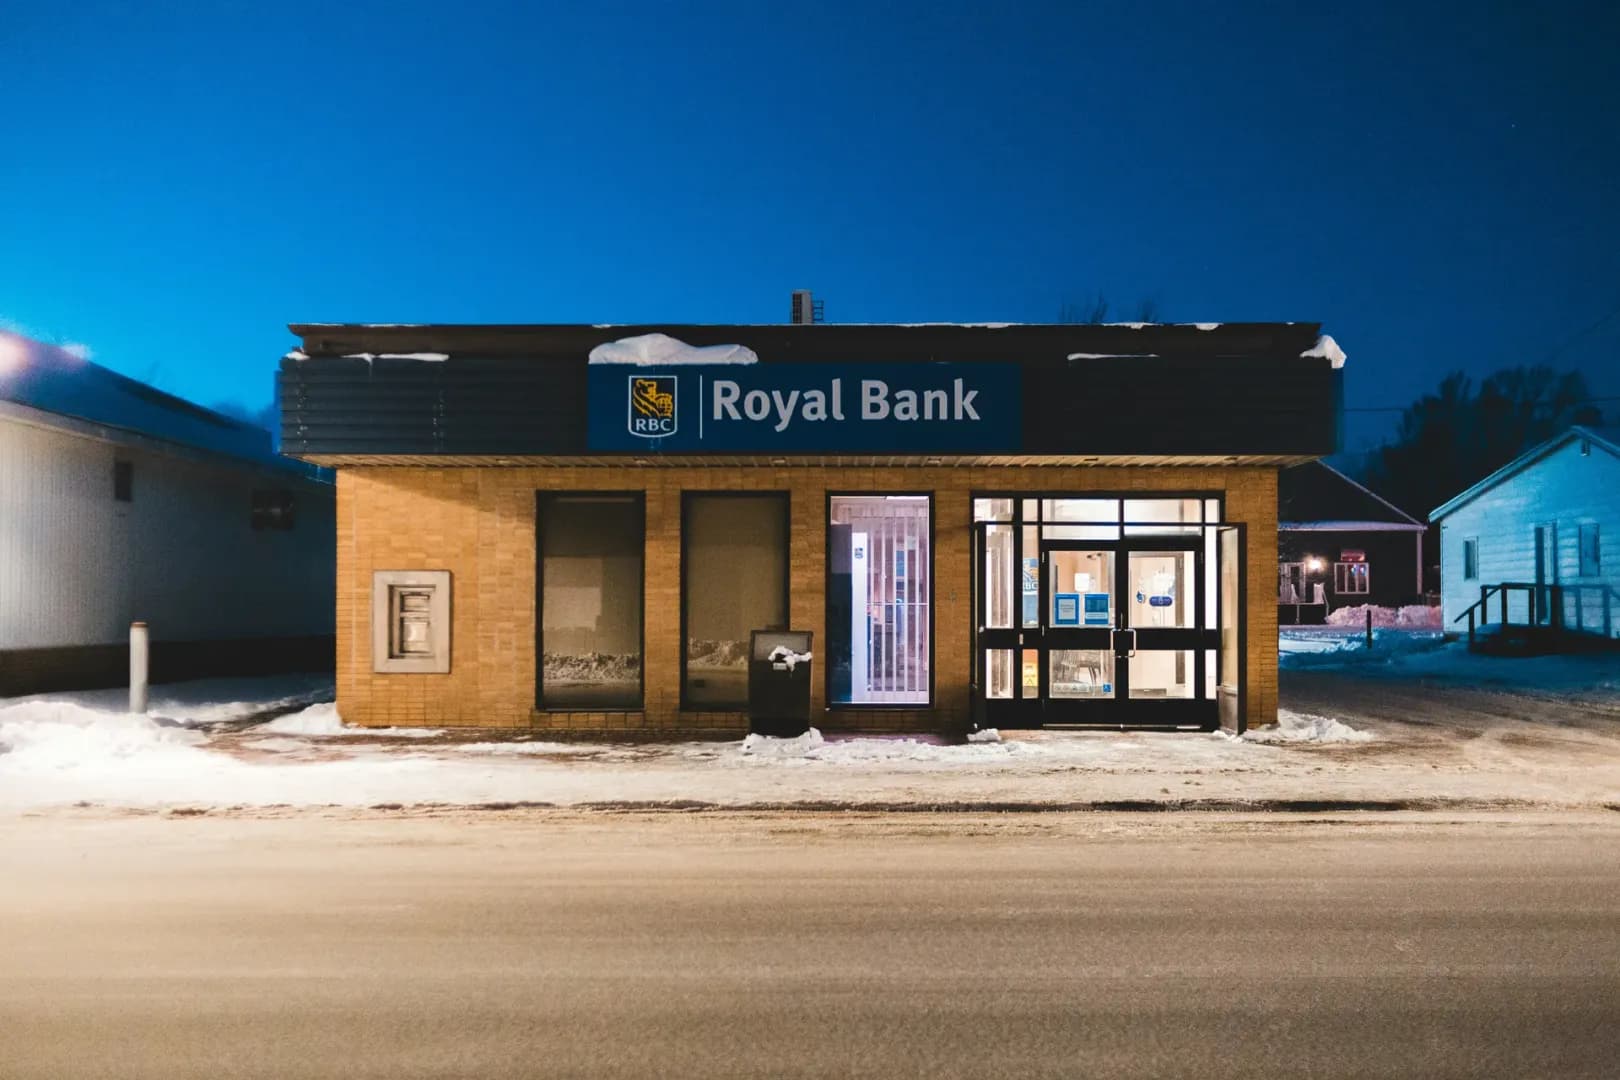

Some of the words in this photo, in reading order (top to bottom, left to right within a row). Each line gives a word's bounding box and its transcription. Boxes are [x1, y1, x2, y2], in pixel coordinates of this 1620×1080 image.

[713, 378, 844, 432] Royal
[861, 378, 981, 421] Bank
[635, 418, 671, 432] RBC
